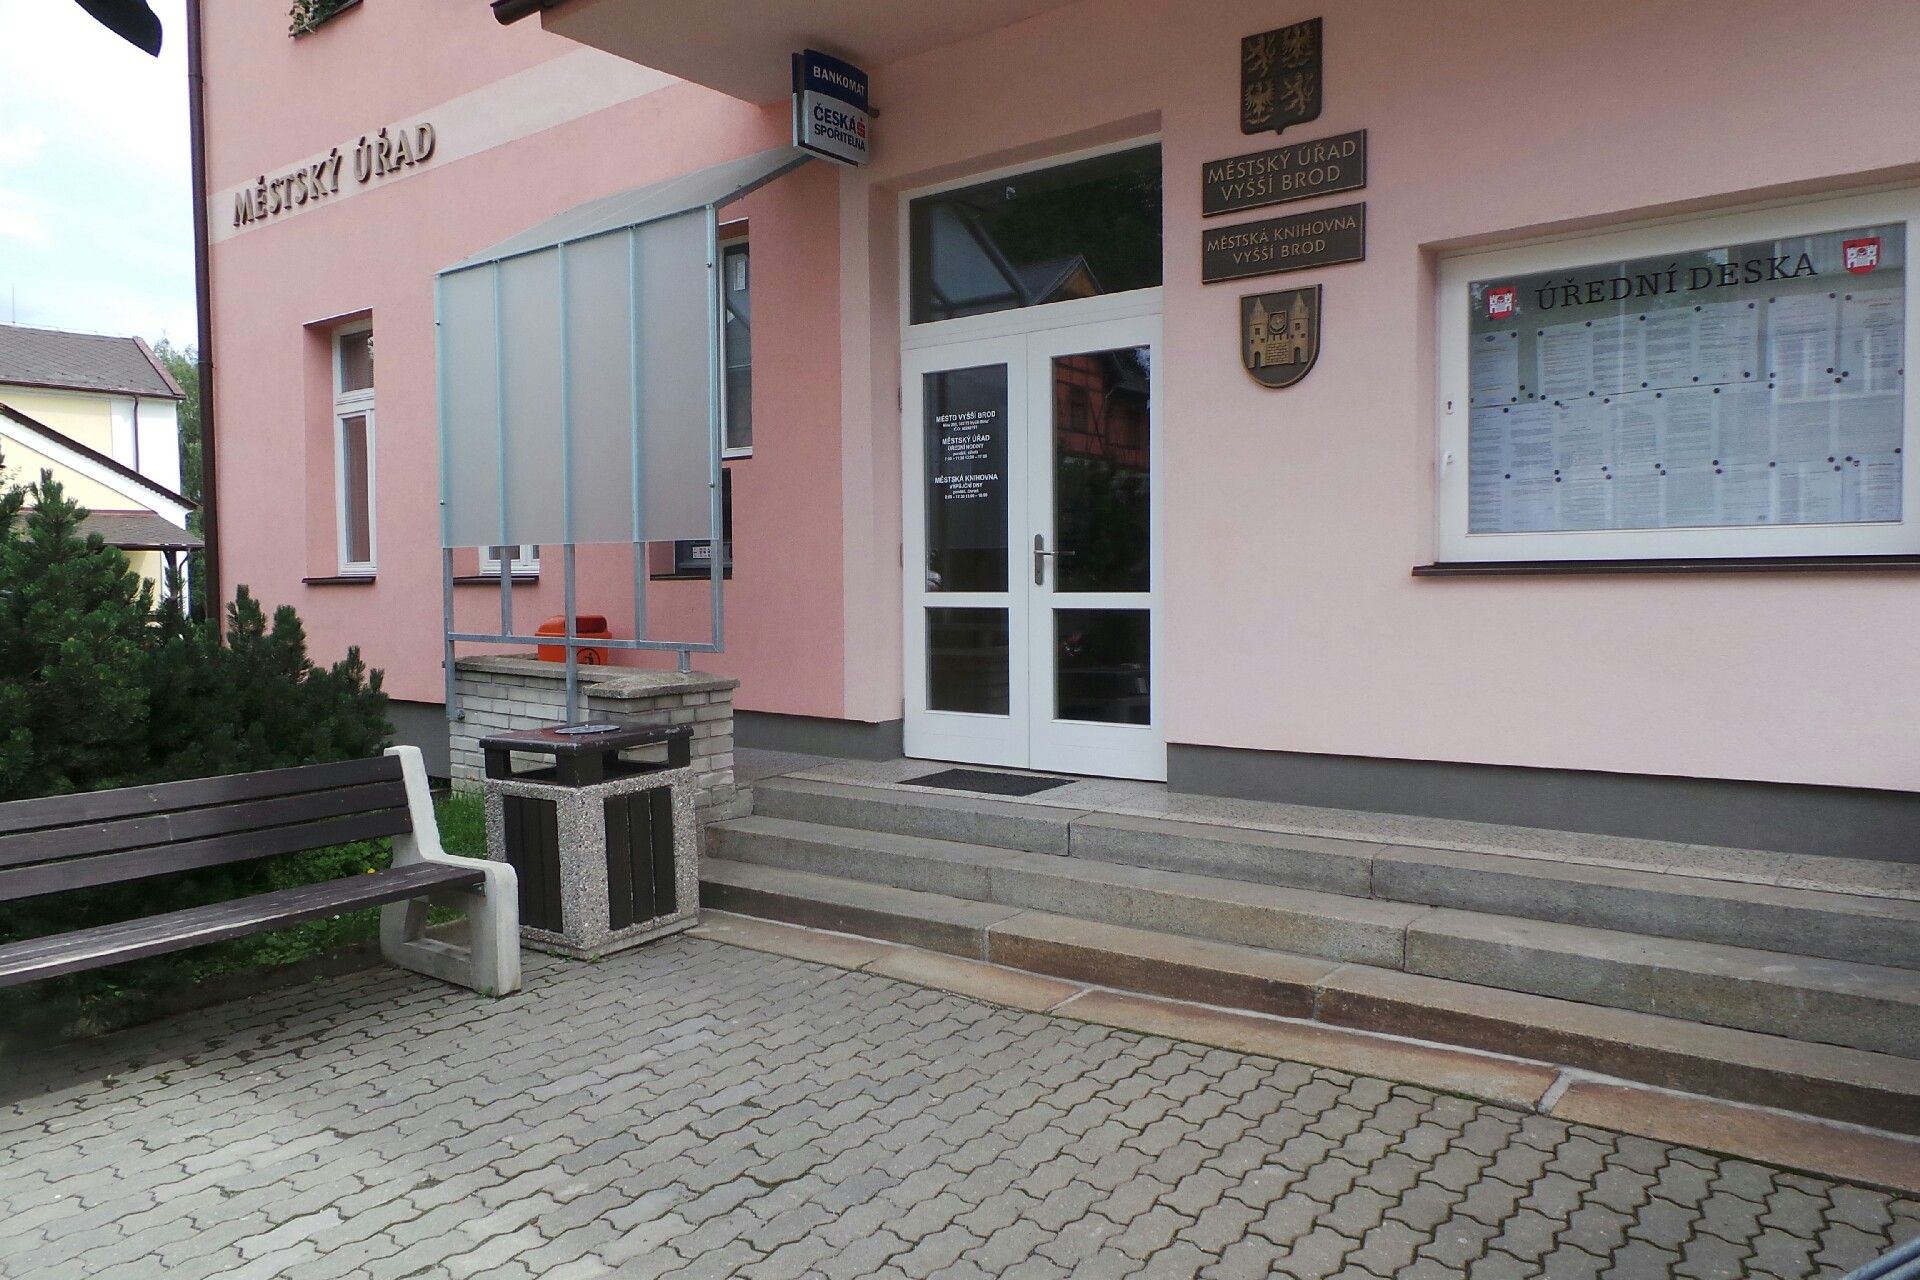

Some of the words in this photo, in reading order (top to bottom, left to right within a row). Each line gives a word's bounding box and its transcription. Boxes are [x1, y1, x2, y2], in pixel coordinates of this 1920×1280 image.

[813, 66, 865, 97] BANKOMAT
[813, 102, 857, 134] ČESKÁ
[814, 123, 865, 152] SPOŘITELNA
[233, 147, 343, 227] MĚSTSKÝ
[353, 122, 436, 184] ÚŘAD
[1207, 150, 1291, 185] MĚSTSKÝ
[1298, 140, 1357, 166] ÚŘAD
[1221, 175, 1274, 201] VYŠŠÍ
[1282, 165, 1341, 191] BROD
[1207, 228, 1269, 252] MĚSTSKÁ
[1274, 216, 1357, 241] KNIHOVNA
[1233, 245, 1274, 264] VYŠŠÍ
[1281, 239, 1326, 258] BROD
[1535, 263, 1678, 311] ÚŘEDNÍ
[1688, 253, 1819, 291] DESKA
[977, 410, 996, 419] BROD
[942, 435, 971, 445] MĚSTSKÝ
[972, 434, 990, 443] ÚŘAD
[934, 474, 964, 484] MĚSTSKÁ
[965, 473, 998, 482] KNIHOVNA
